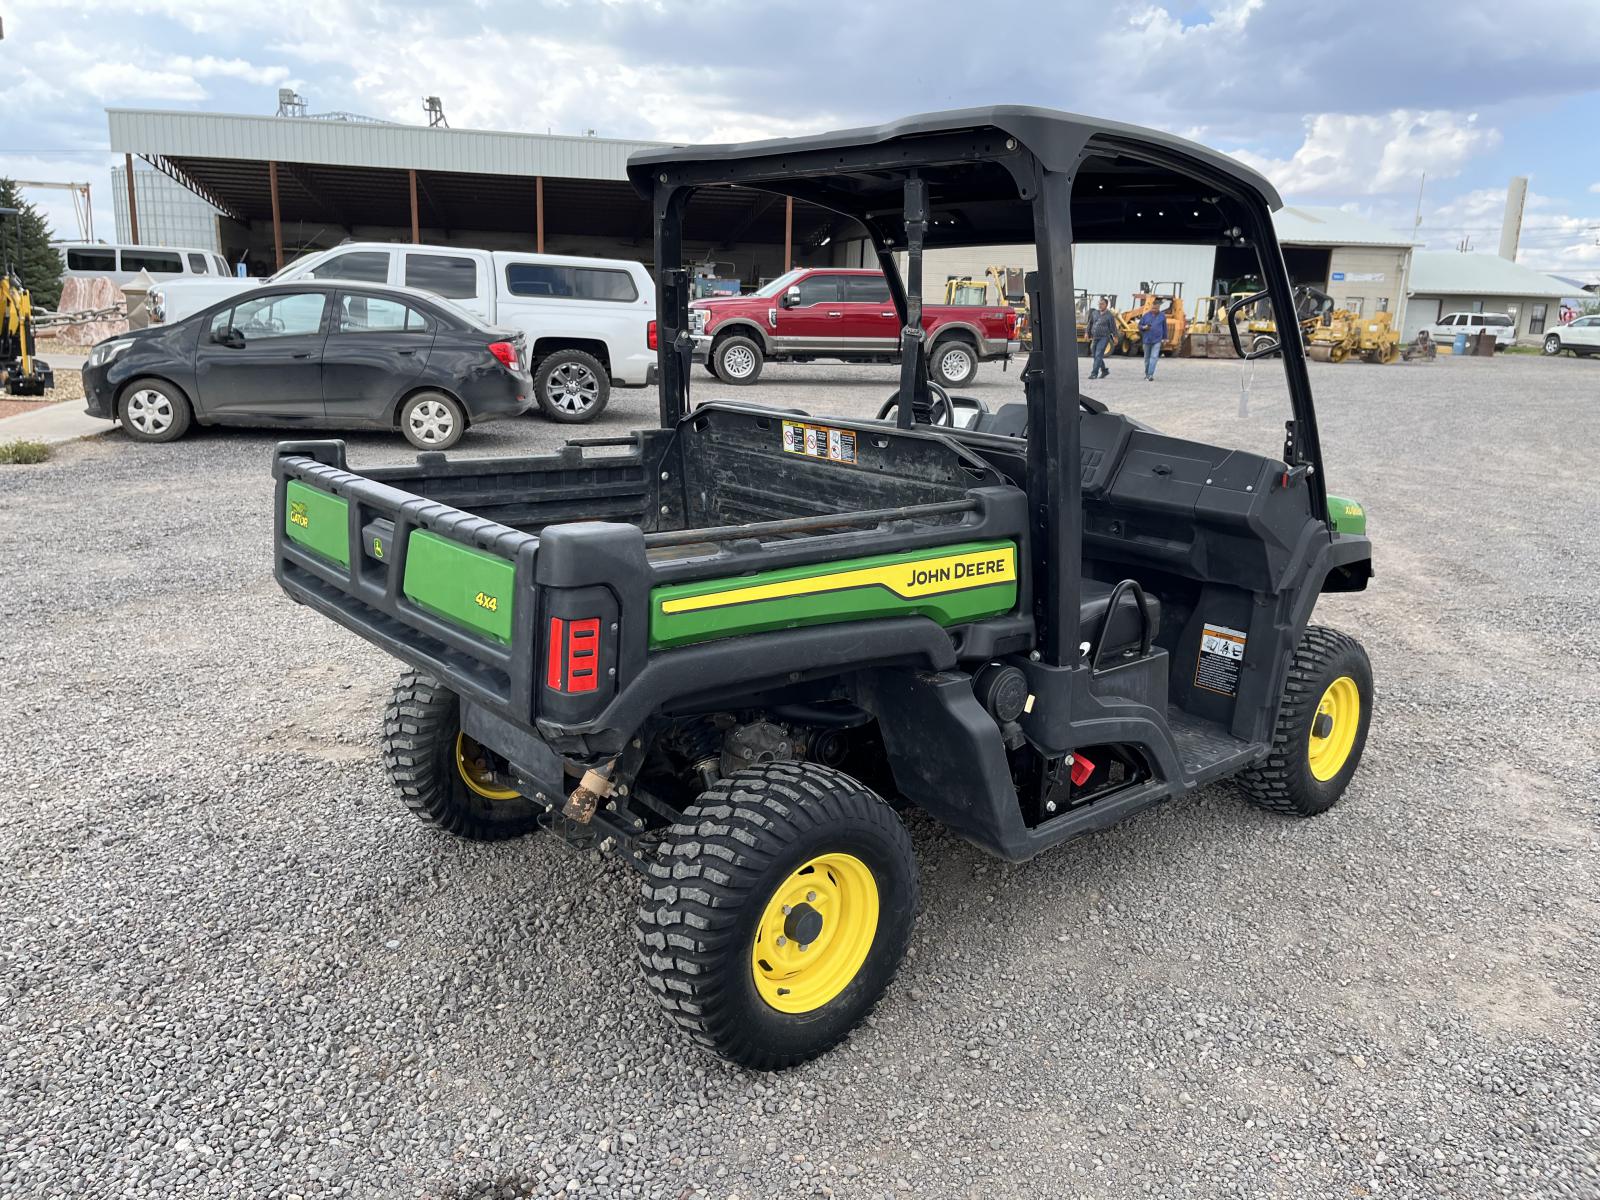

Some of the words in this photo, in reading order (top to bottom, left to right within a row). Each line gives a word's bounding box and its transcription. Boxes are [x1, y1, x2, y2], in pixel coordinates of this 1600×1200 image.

[290, 510, 308, 528] GATOR
[907, 568, 951, 587] JOHN
[954, 559, 1005, 579] DEERE
